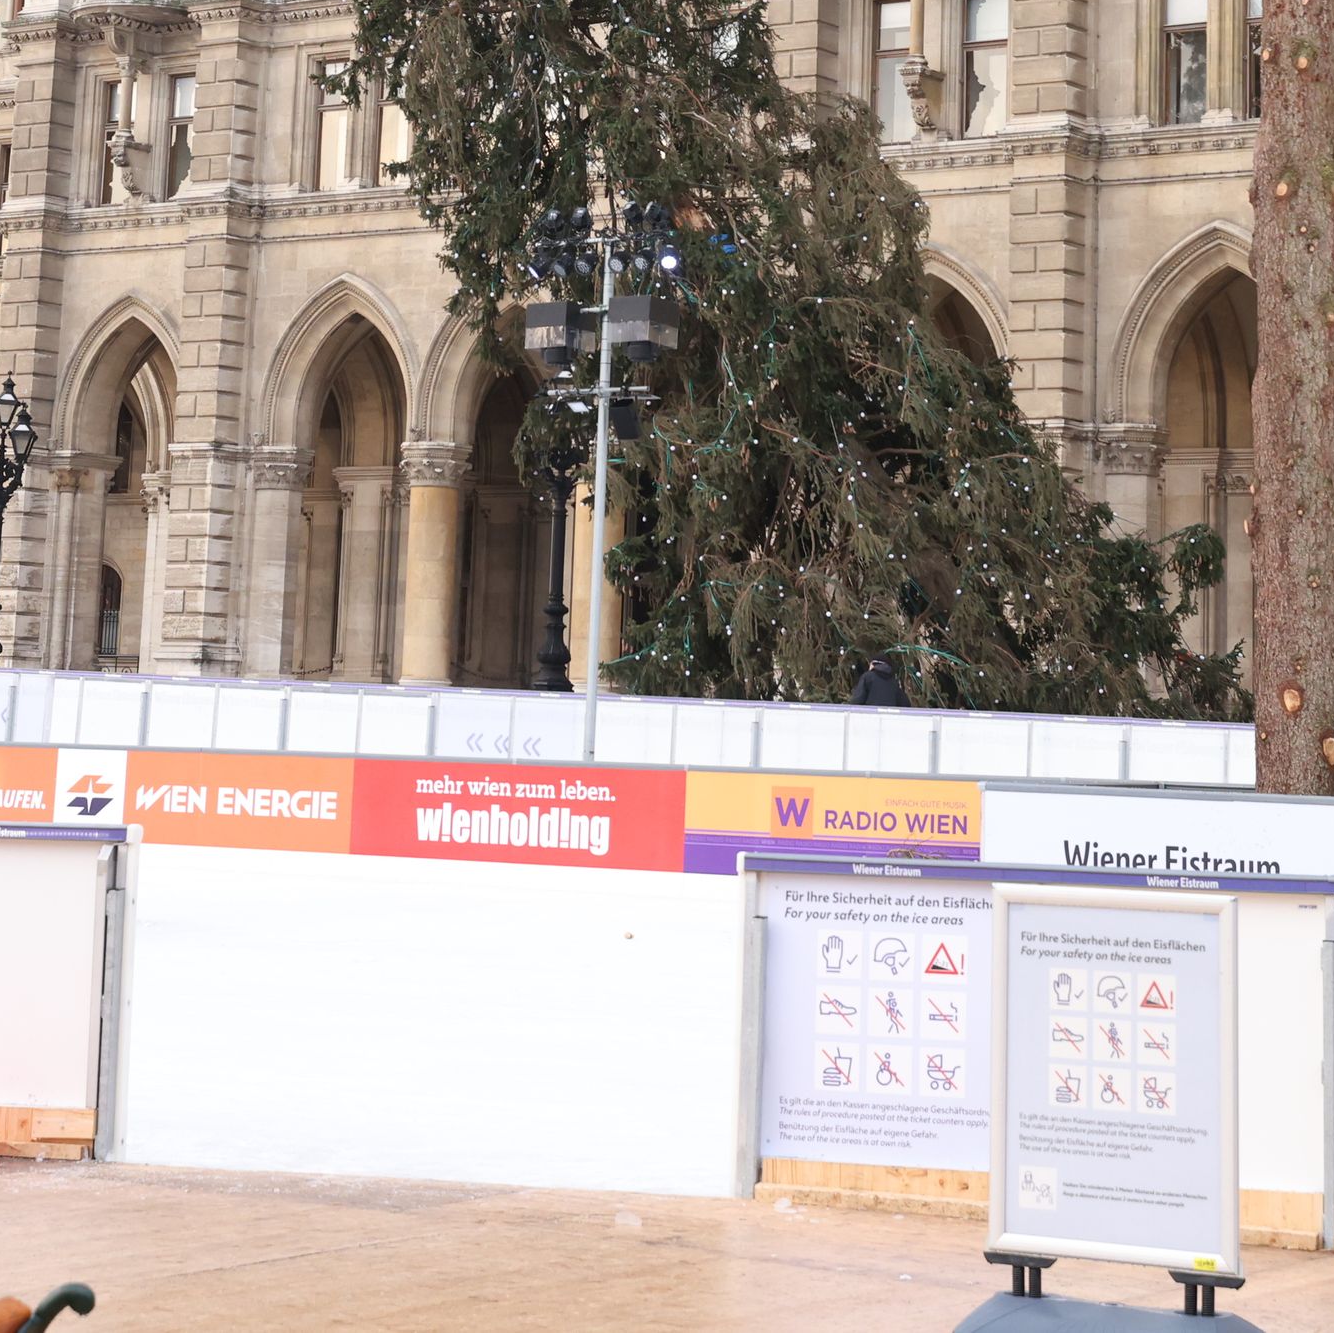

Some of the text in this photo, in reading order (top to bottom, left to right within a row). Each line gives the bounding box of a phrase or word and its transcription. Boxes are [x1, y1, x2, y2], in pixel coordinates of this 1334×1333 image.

[416, 775, 616, 802] mehr wien zum leben.
[136, 784, 338, 820] WIEN ENERGIE
[774, 796, 810, 827] W
[824, 809, 968, 835] RADIO WIEN
[1063, 840, 1281, 874] Wiener Eistraum
[852, 863, 922, 877] Wiener Eistraum
[1146, 875, 1219, 890] Wiener Eistraum
[785, 889, 804, 902] Für
[806, 890, 830, 904] Ihre
[832, 892, 892, 906] Sicherheit
[895, 894, 914, 907] auf
[917, 895, 940, 909] den
[784, 906, 964, 926] For your safety on the ice areas
[1021, 930, 1206, 953] Für Ihre Sicherheit auf den Eisflächen
[1020, 946, 1172, 965] For your safety on the ice areas
